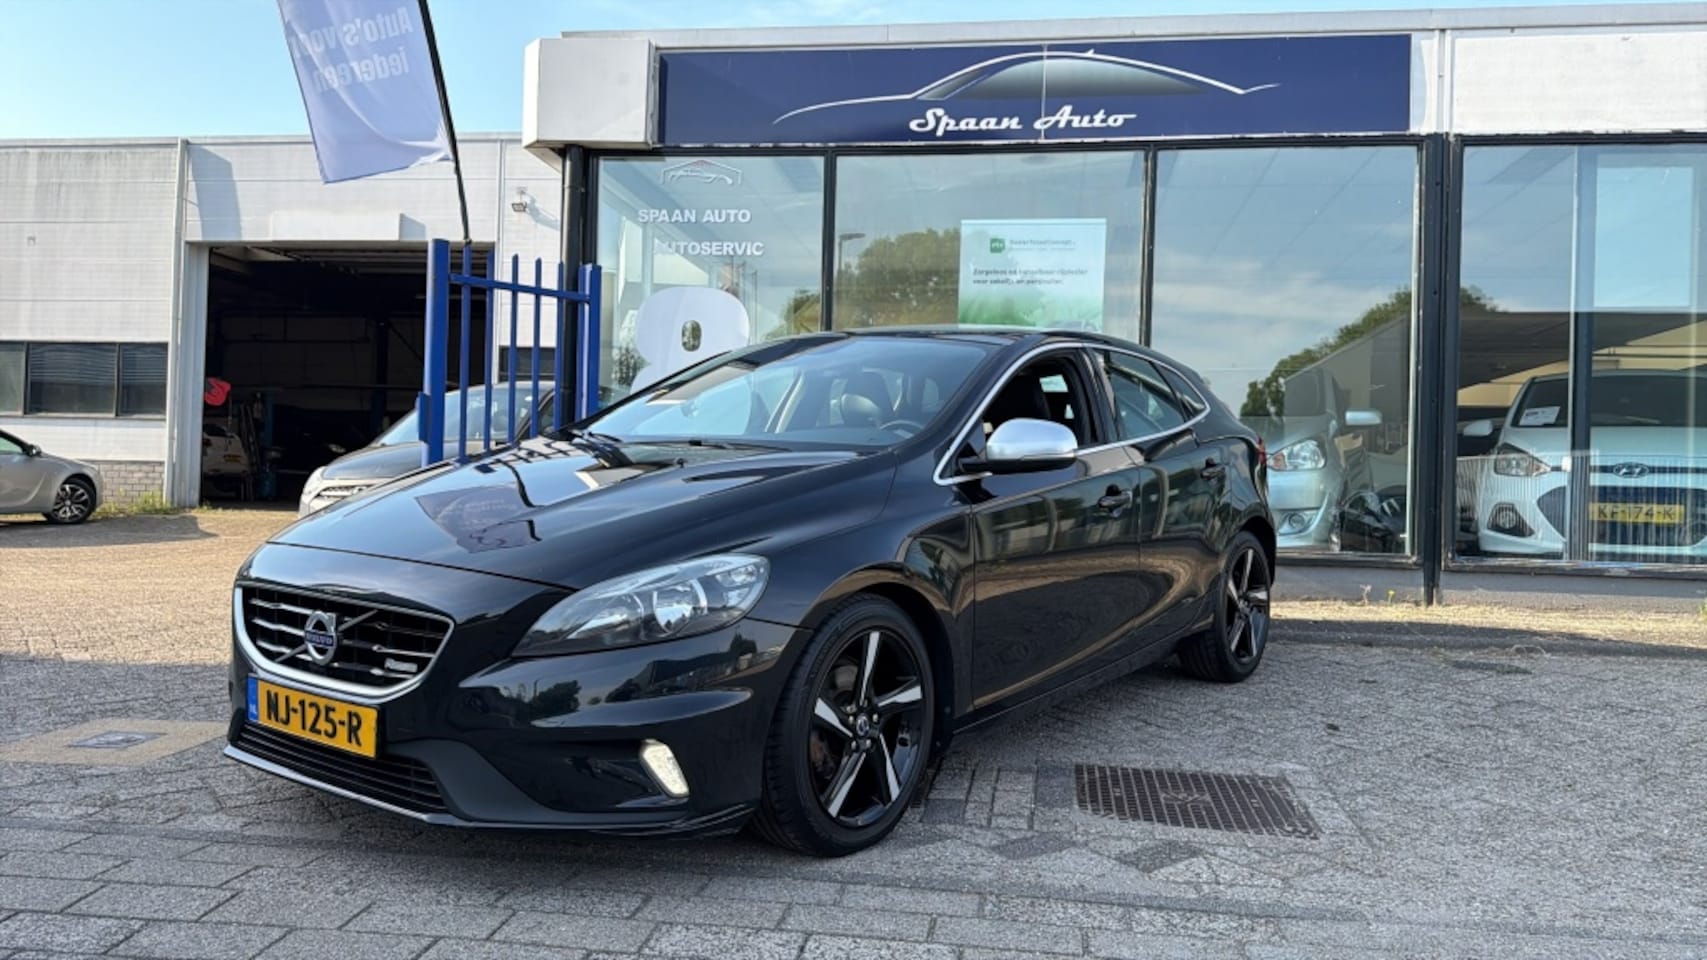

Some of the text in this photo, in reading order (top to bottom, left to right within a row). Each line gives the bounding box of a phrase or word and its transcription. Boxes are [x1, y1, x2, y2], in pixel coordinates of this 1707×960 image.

[909, 104, 1138, 137] Spaan Auto
[638, 208, 752, 223] SPAAN AUTO
[266, 689, 363, 747] NJ-125-R
